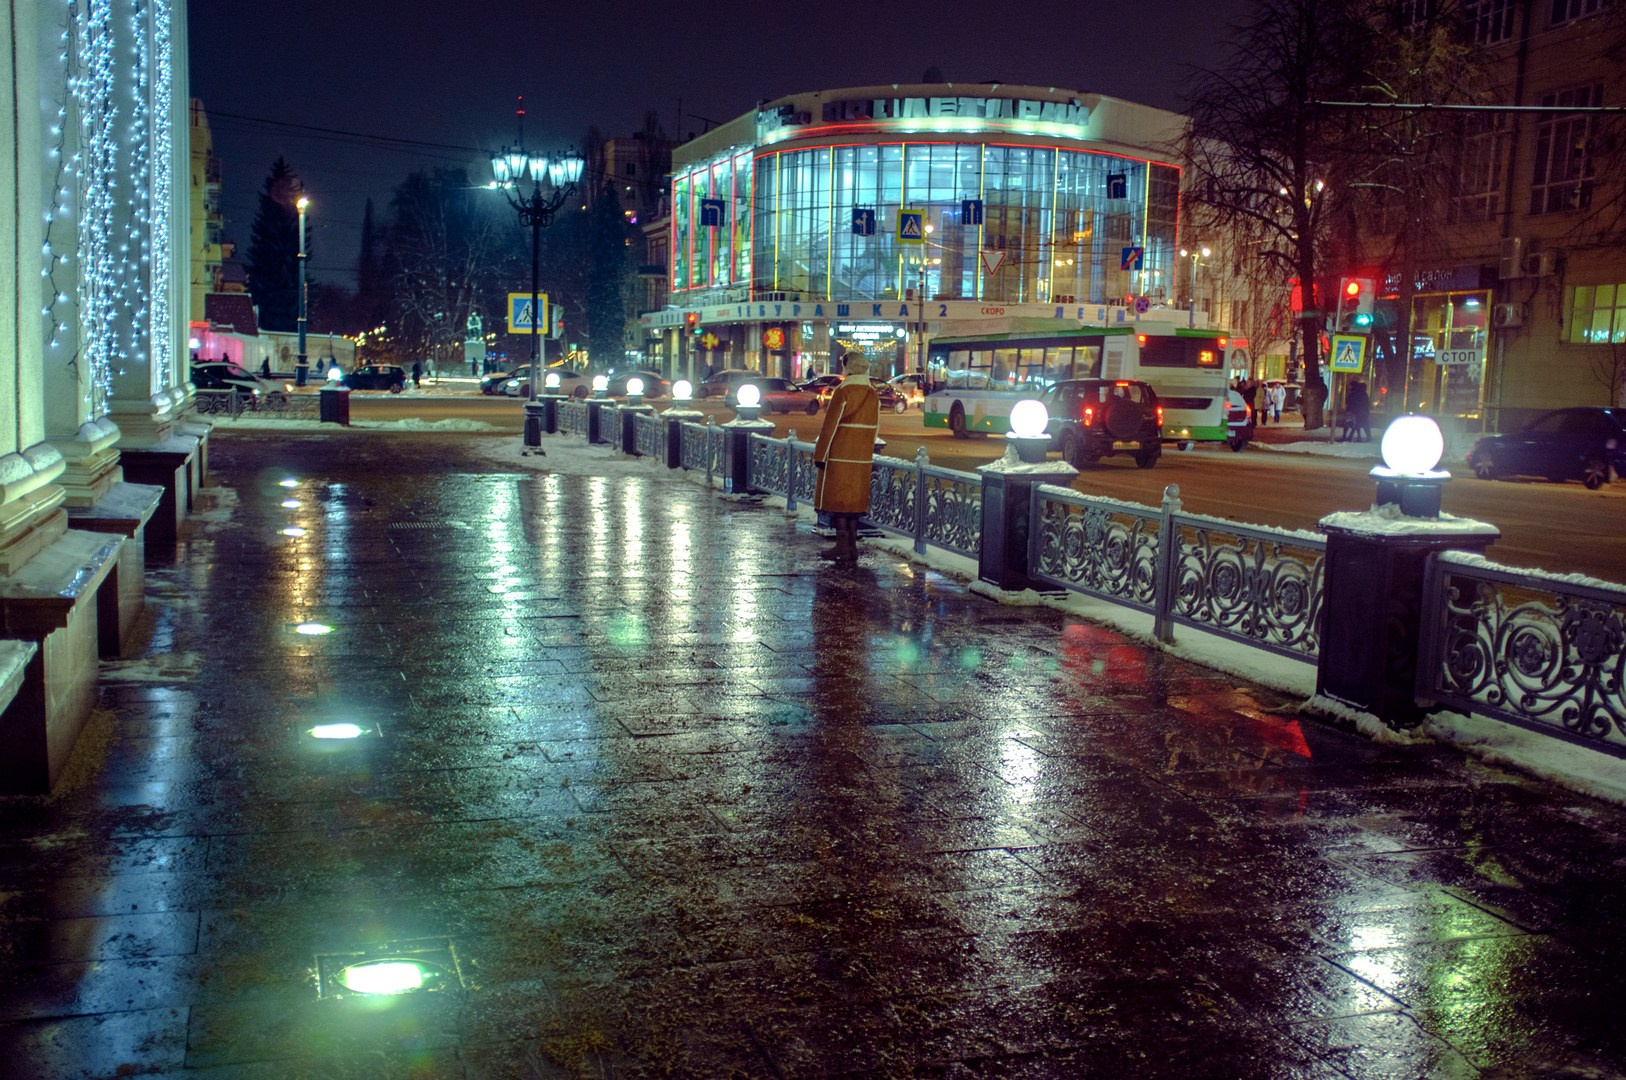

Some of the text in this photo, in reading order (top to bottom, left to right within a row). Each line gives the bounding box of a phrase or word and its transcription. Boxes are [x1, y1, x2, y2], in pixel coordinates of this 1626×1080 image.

[737, 303, 909, 318] ЧЕБУРАШКА
[938, 304, 948, 317] 2
[980, 306, 1005, 317] СКОРО
[1200, 351, 1213, 362] 21
[1441, 351, 1476, 363] СТОП
